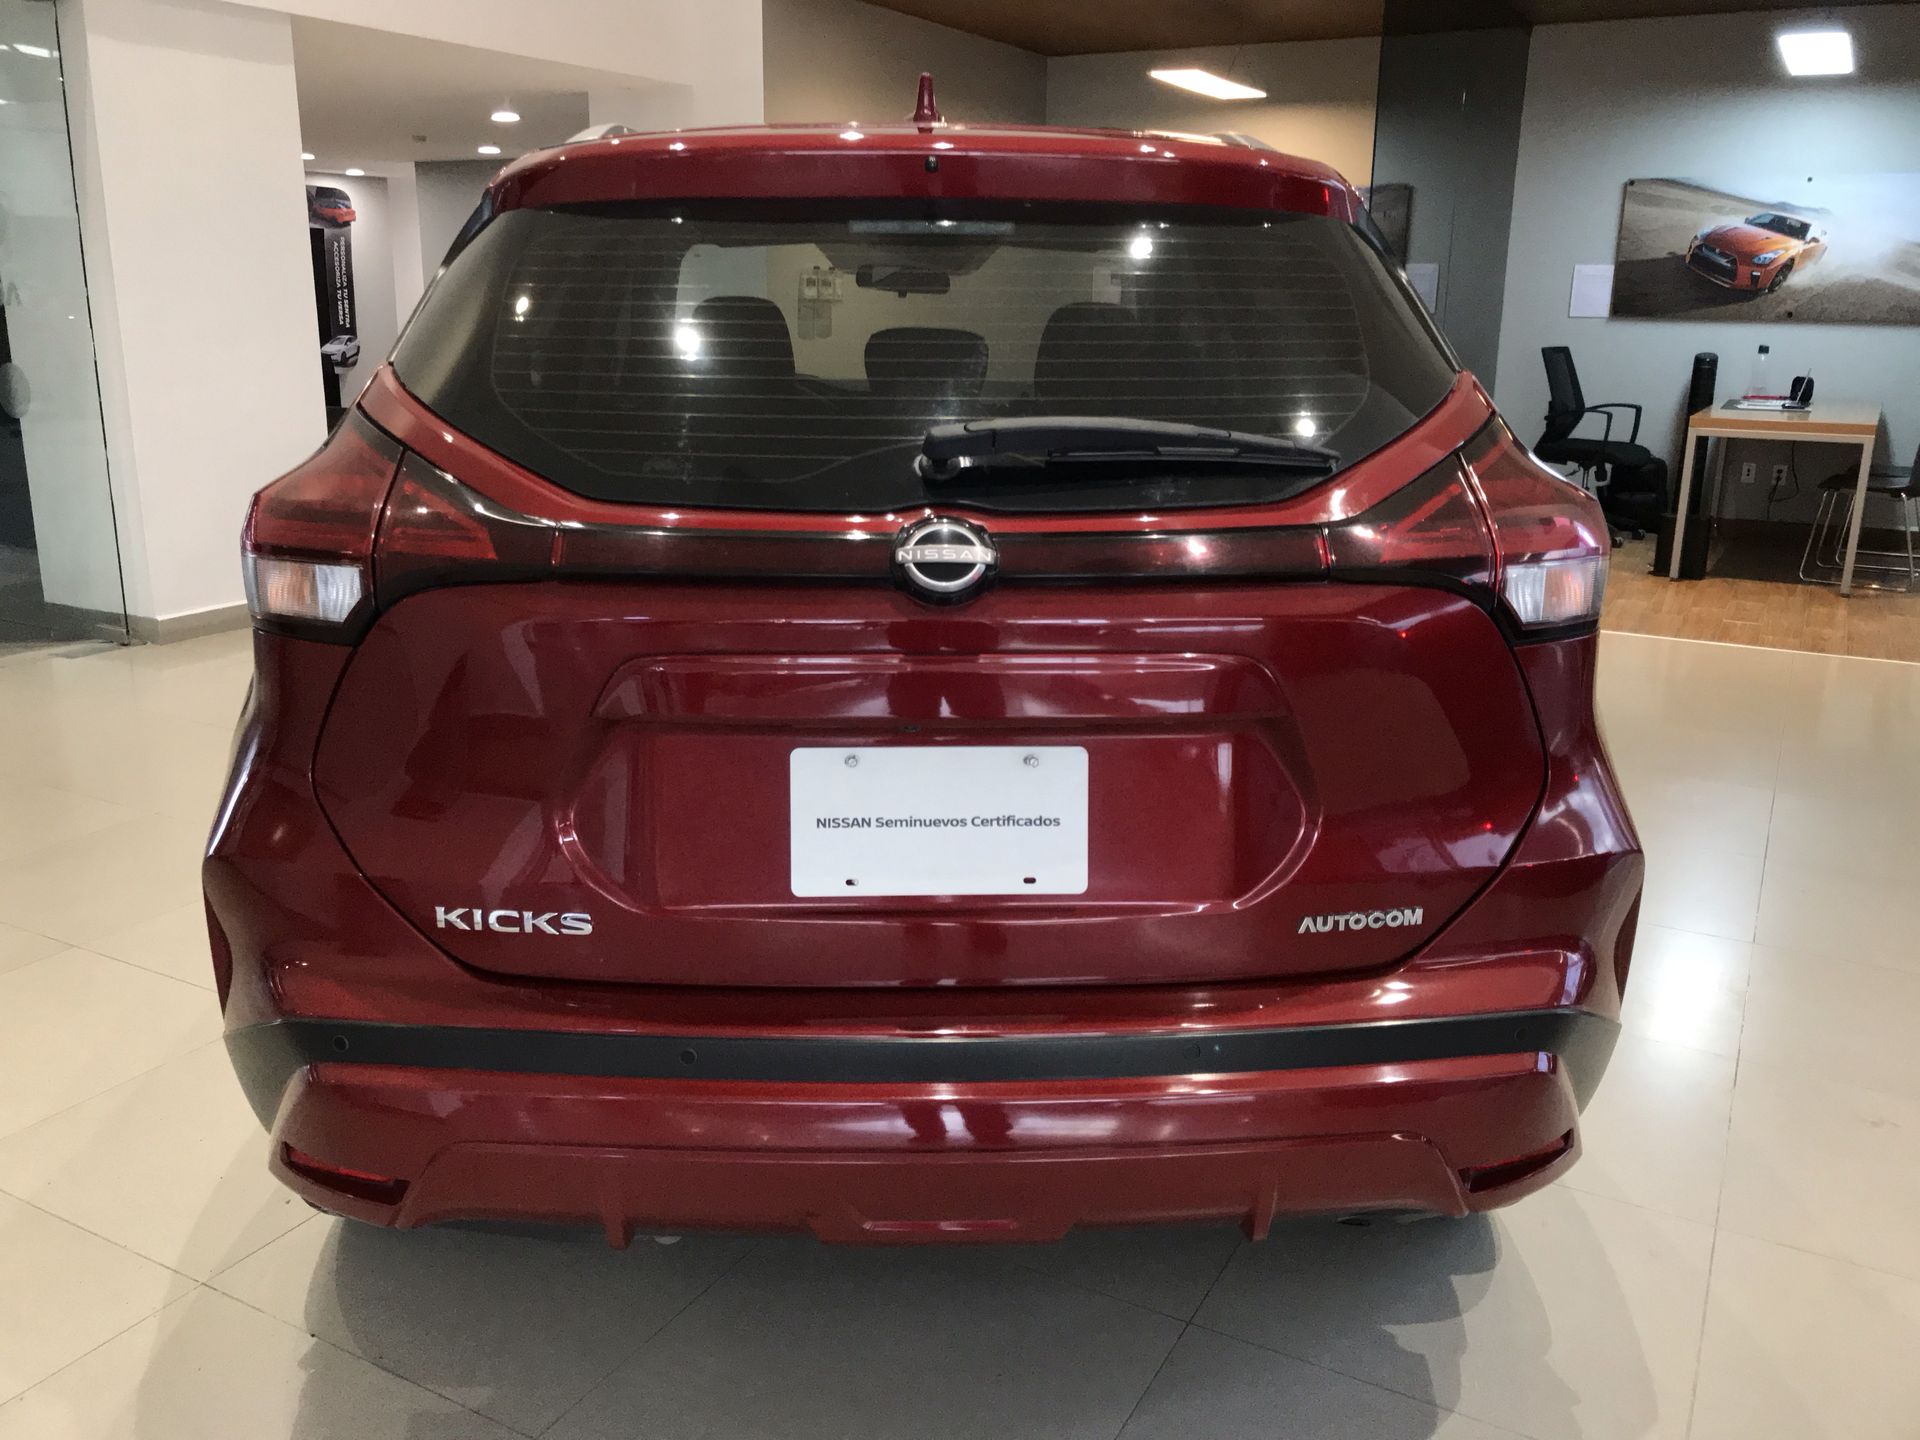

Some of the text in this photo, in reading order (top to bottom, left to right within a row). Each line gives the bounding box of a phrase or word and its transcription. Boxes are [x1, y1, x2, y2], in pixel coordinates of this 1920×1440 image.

[333, 241, 341, 288] ACCESORIZA
[337, 289, 342, 300] TU
[343, 288, 348, 299] TU
[898, 549, 992, 562] NISSAN
[816, 814, 1061, 829] NISSAN Seminuevos Certificados
[435, 906, 593, 936] KICKS
[1298, 907, 1424, 934] AUTOCOM
